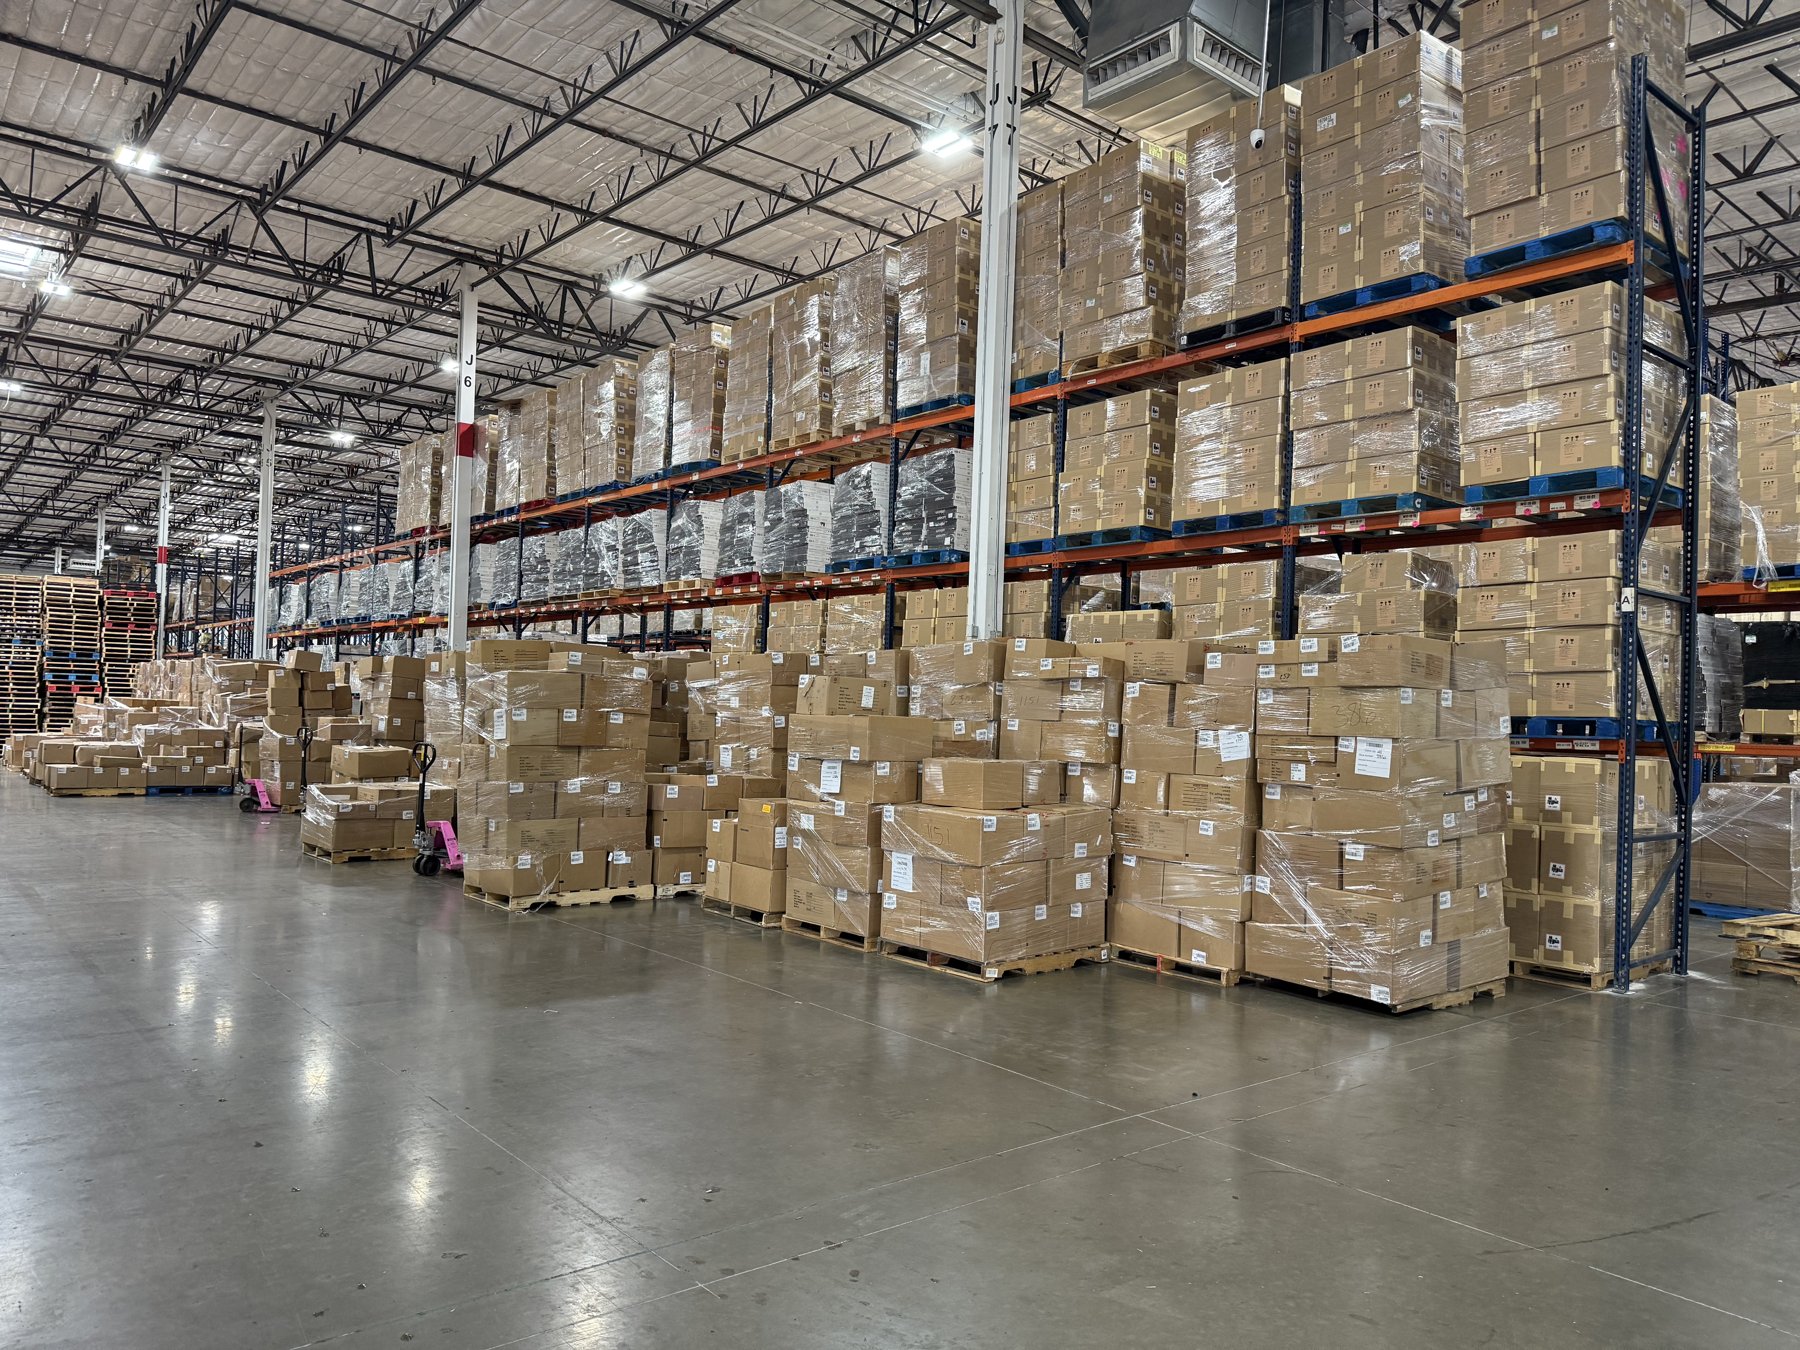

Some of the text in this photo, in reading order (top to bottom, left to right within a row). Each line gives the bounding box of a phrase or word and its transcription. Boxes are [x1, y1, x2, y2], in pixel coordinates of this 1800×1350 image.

[989, 83, 999, 106] J
[1006, 85, 1017, 145] J 7
[464, 354, 473, 387] J 6
[1414, 498, 1422, 509] C
[1621, 596, 1631, 605] A
